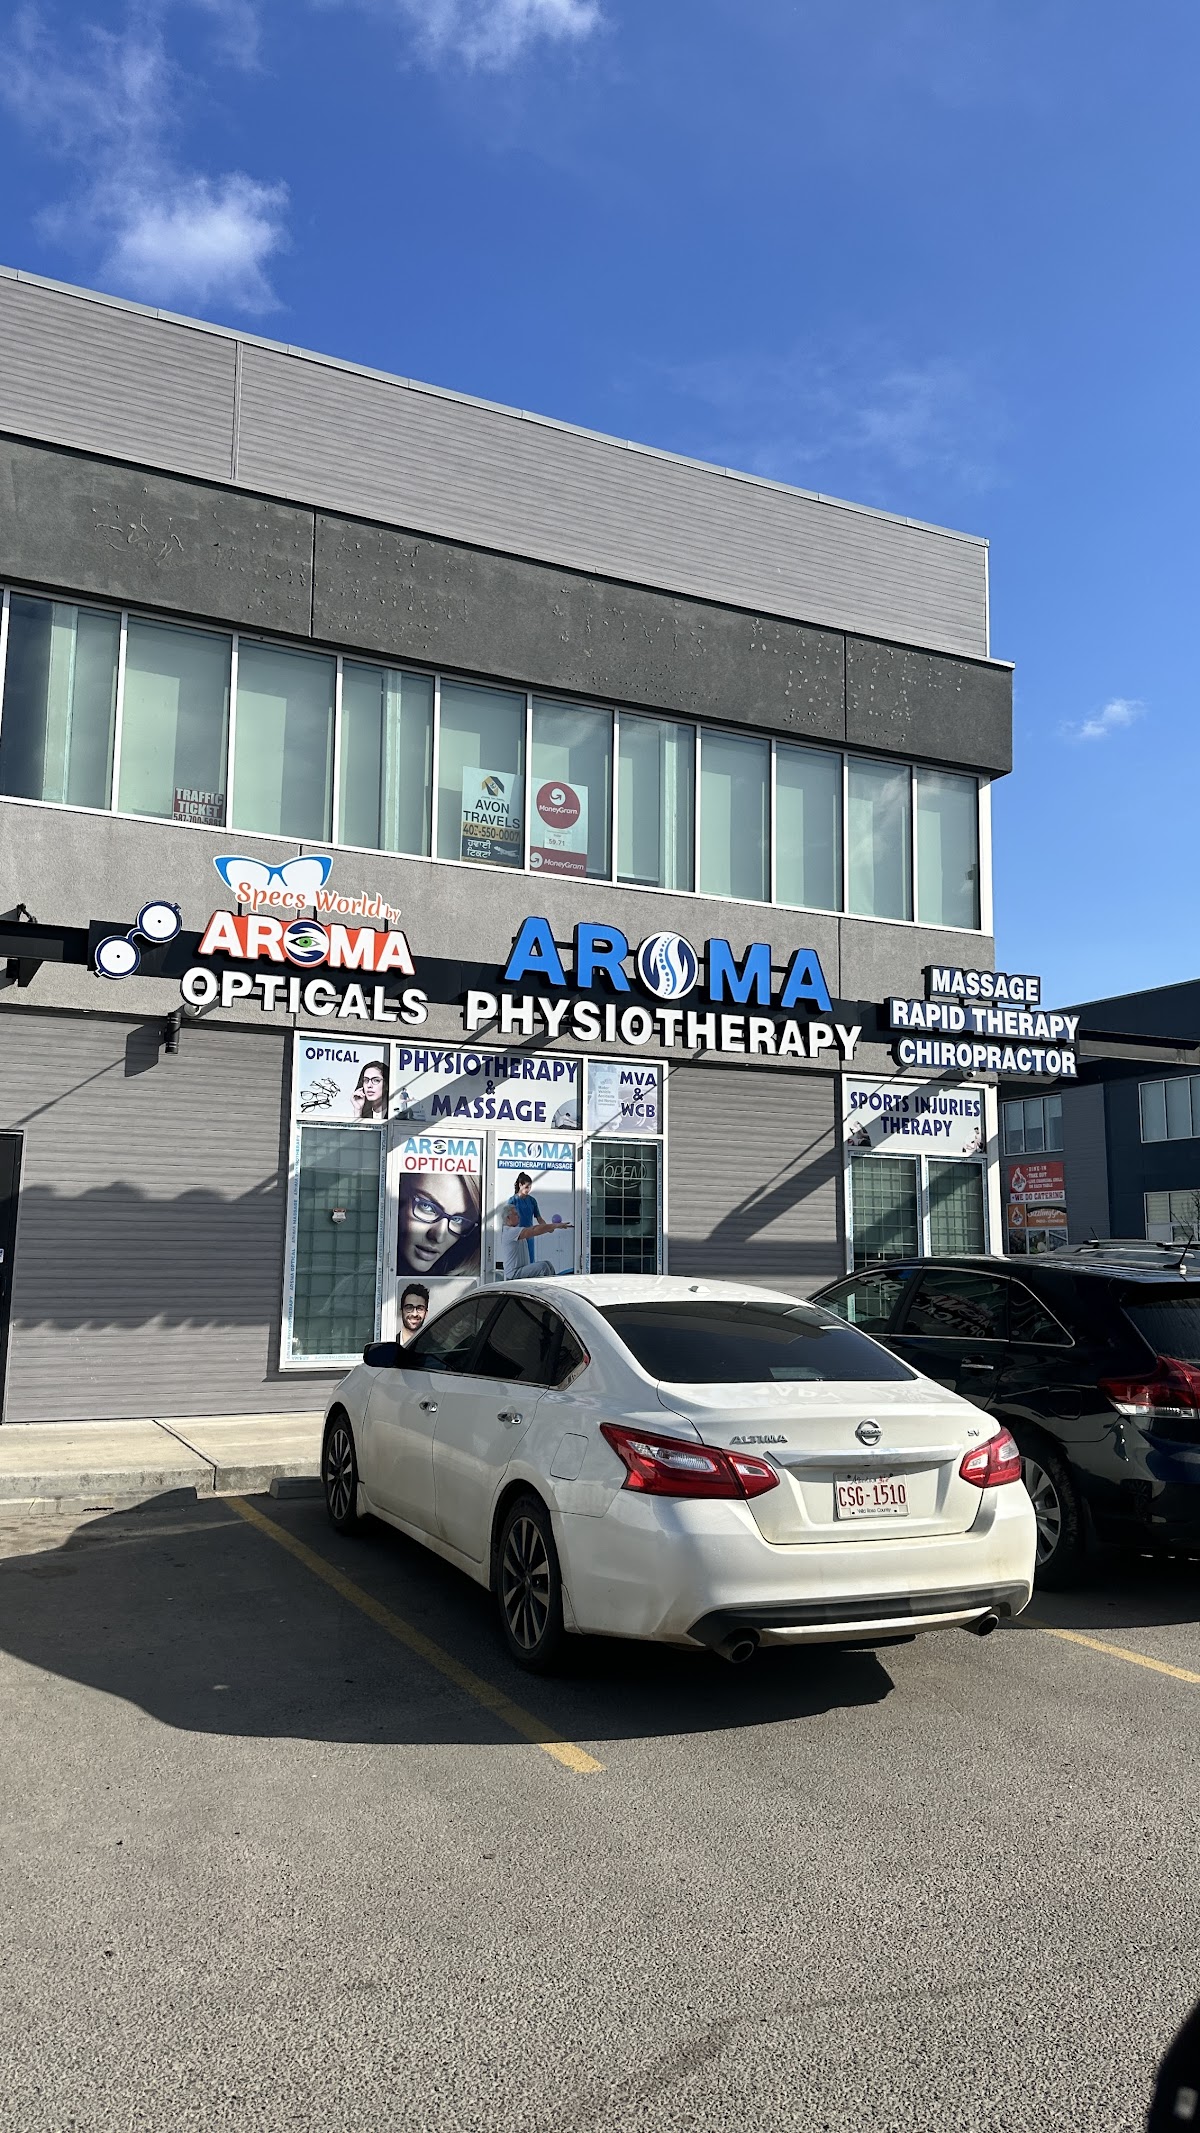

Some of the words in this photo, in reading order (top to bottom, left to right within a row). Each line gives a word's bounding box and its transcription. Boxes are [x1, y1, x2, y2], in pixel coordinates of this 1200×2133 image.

[176, 788, 223, 806] TRAFFIC
[178, 800, 220, 817] TICKET
[475, 800, 510, 814] AVON
[539, 804, 578, 814] MoneyGram
[463, 810, 520, 829] TRAVELS
[544, 858, 584, 870] MoneyGram
[236, 881, 306, 911] Specs
[315, 889, 381, 918] World
[385, 907, 401, 924] by
[199, 911, 415, 975] AROMA
[505, 916, 833, 1011] AROMA
[931, 968, 1039, 1002] MASSAGE
[181, 967, 428, 1024] OPTICALS
[466, 990, 862, 1060] PHYSIOTHERAPY
[892, 1000, 966, 1031] RAPID
[971, 1009, 1080, 1040] THERAPY
[305, 1048, 360, 1063] OPTICAL
[899, 1039, 1077, 1076] CHIROPRACTOR
[399, 1049, 579, 1083] PHYSIOTHERAPY
[485, 1080, 496, 1095] &
[620, 1071, 657, 1086] MVA
[632, 1088, 644, 1100] &
[431, 1095, 547, 1123] MASSAGE
[620, 1103, 656, 1118] WCB
[850, 1092, 909, 1112] SPORTS
[915, 1096, 980, 1117] INJURIES
[881, 1116, 952, 1136] THERAPY
[404, 1138, 478, 1156] AROMA
[498, 1142, 573, 1160] AROMA
[404, 1156, 477, 1173] OPTICAL
[499, 1161, 544, 1170] PHYSIOTHERAPY
[604, 1165, 642, 1180] OPEN
[1034, 1192, 1063, 1200] CATERING
[729, 1435, 788, 1445] ALTIMA
[838, 1484, 906, 1507] CSG-1510
